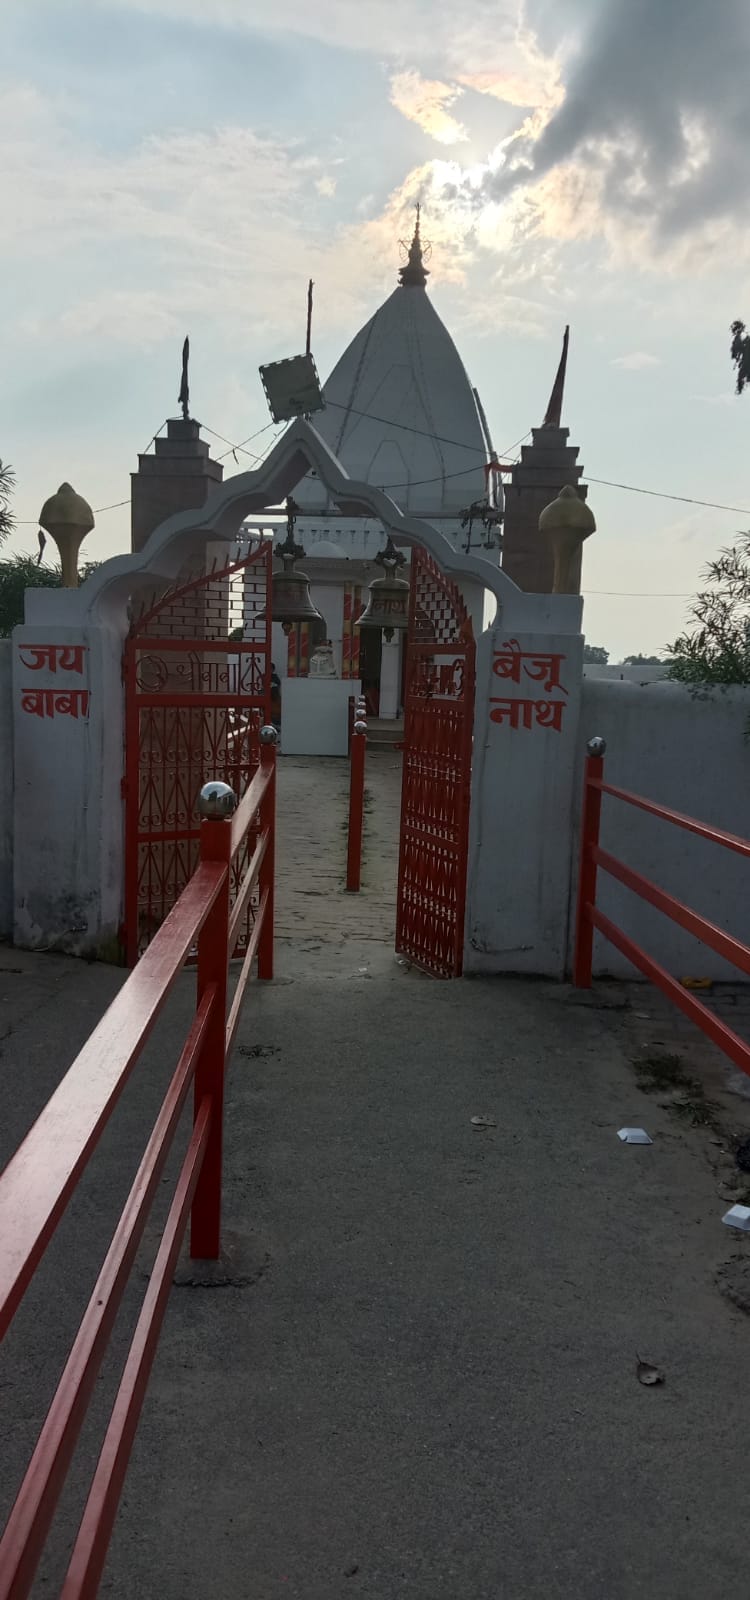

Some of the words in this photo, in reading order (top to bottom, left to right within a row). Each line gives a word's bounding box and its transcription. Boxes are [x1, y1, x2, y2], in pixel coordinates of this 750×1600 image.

[18, 644, 86, 674] जय
[493, 638, 568, 695] बैजू
[20, 688, 89, 719] बाबा
[489, 697, 567, 733] नाथ
